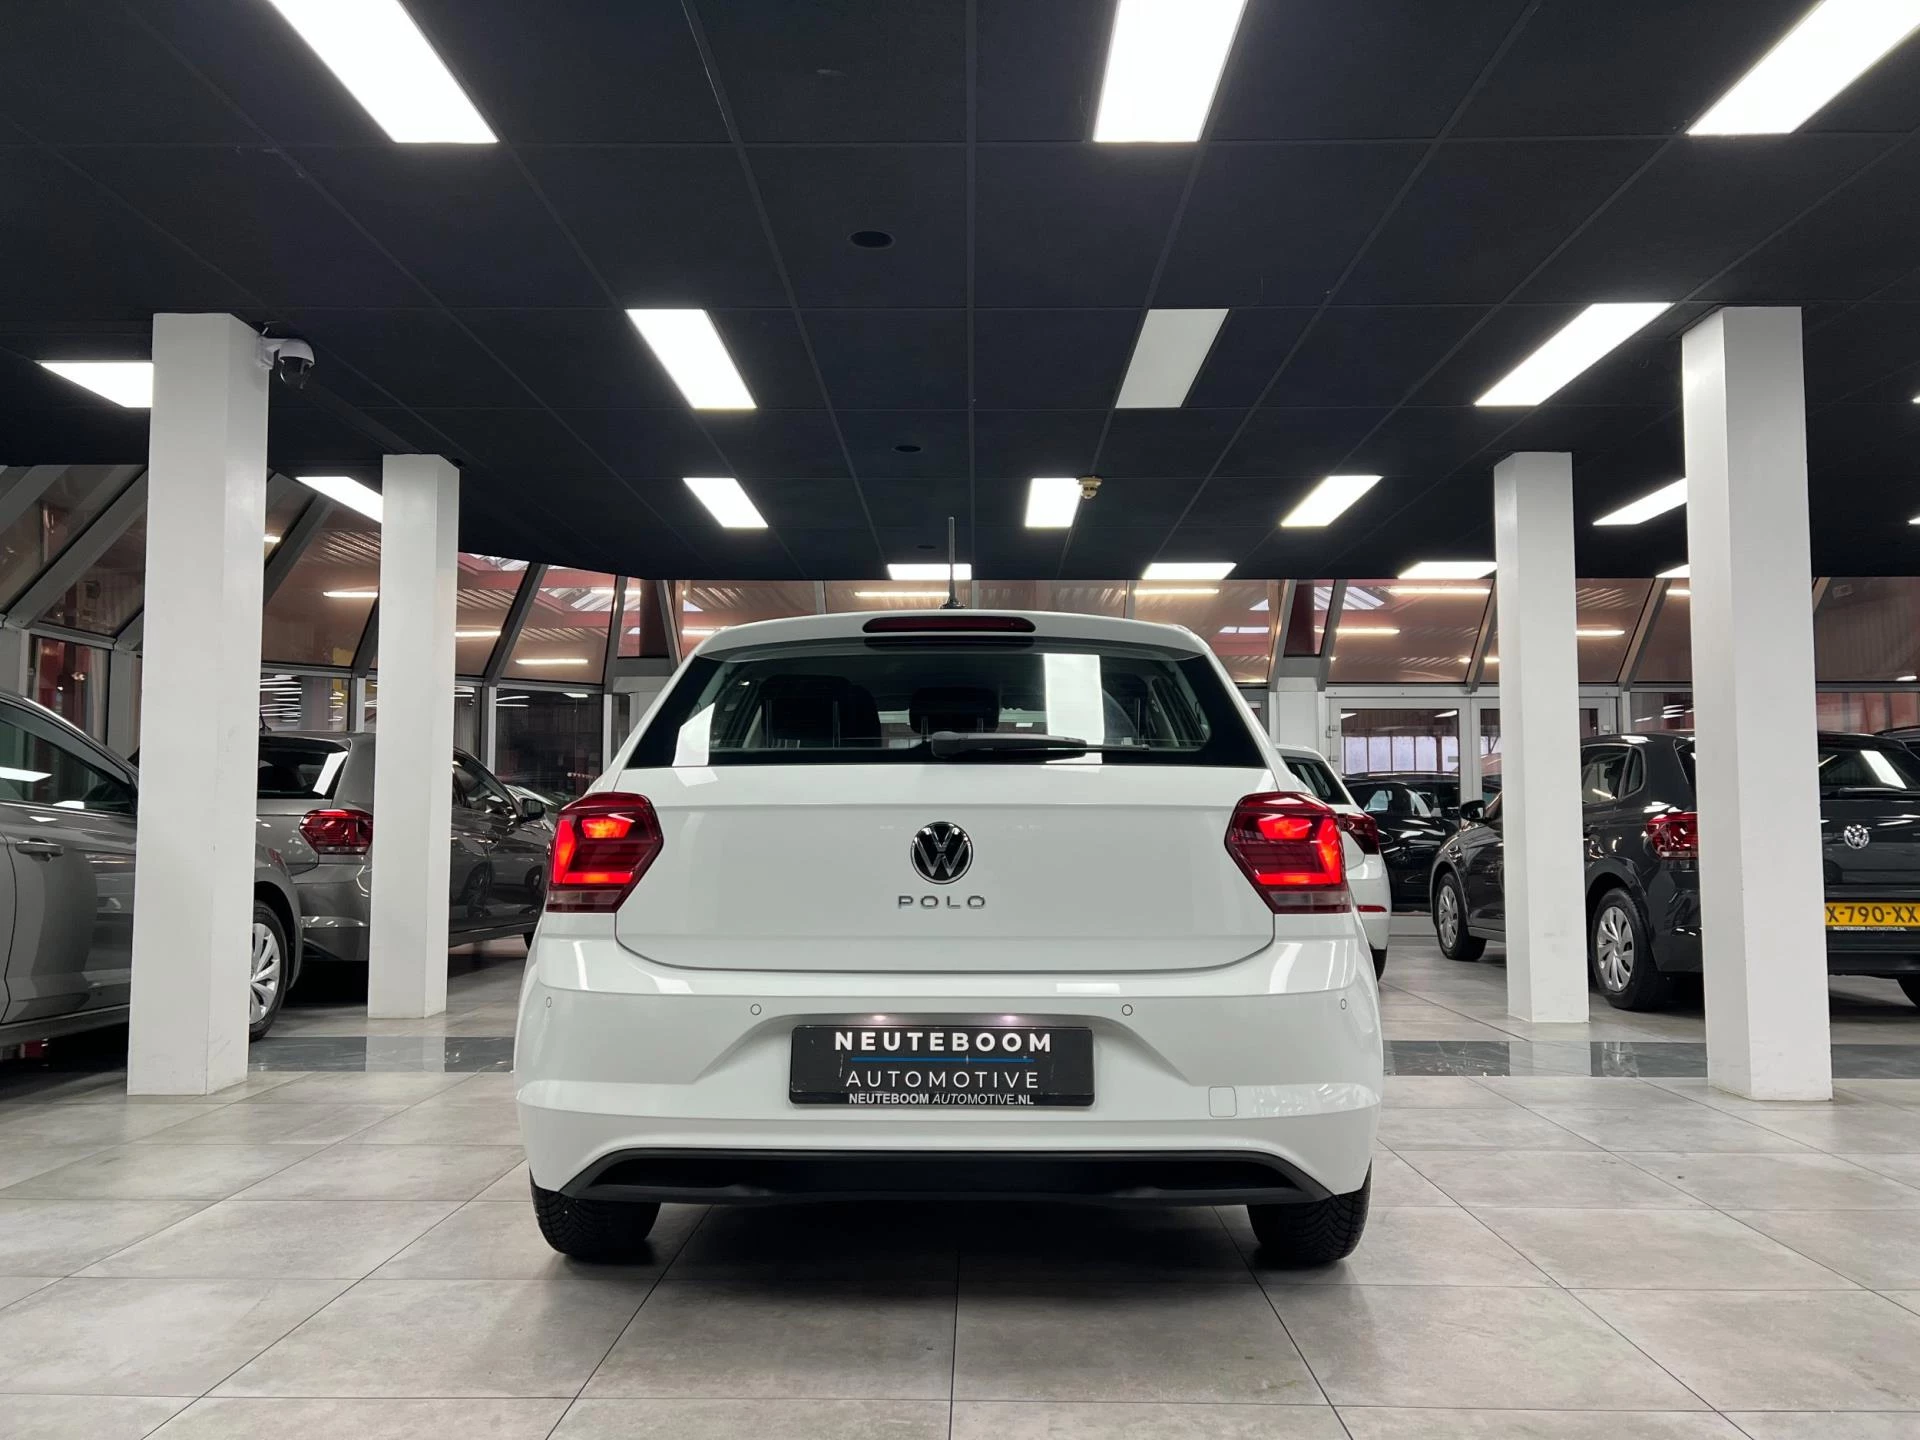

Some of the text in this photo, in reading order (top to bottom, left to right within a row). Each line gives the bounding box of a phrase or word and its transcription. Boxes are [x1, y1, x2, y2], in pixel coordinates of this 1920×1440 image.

[898, 895, 985, 909] POLO
[1826, 906, 1919, 923] X-790-XX
[835, 1031, 1052, 1053] NEUTEBOOM
[846, 1070, 1038, 1089] AUTOMOTIVE
[849, 1093, 1035, 1105] NEUTEBOOM AUTOMOTIVE.NL
